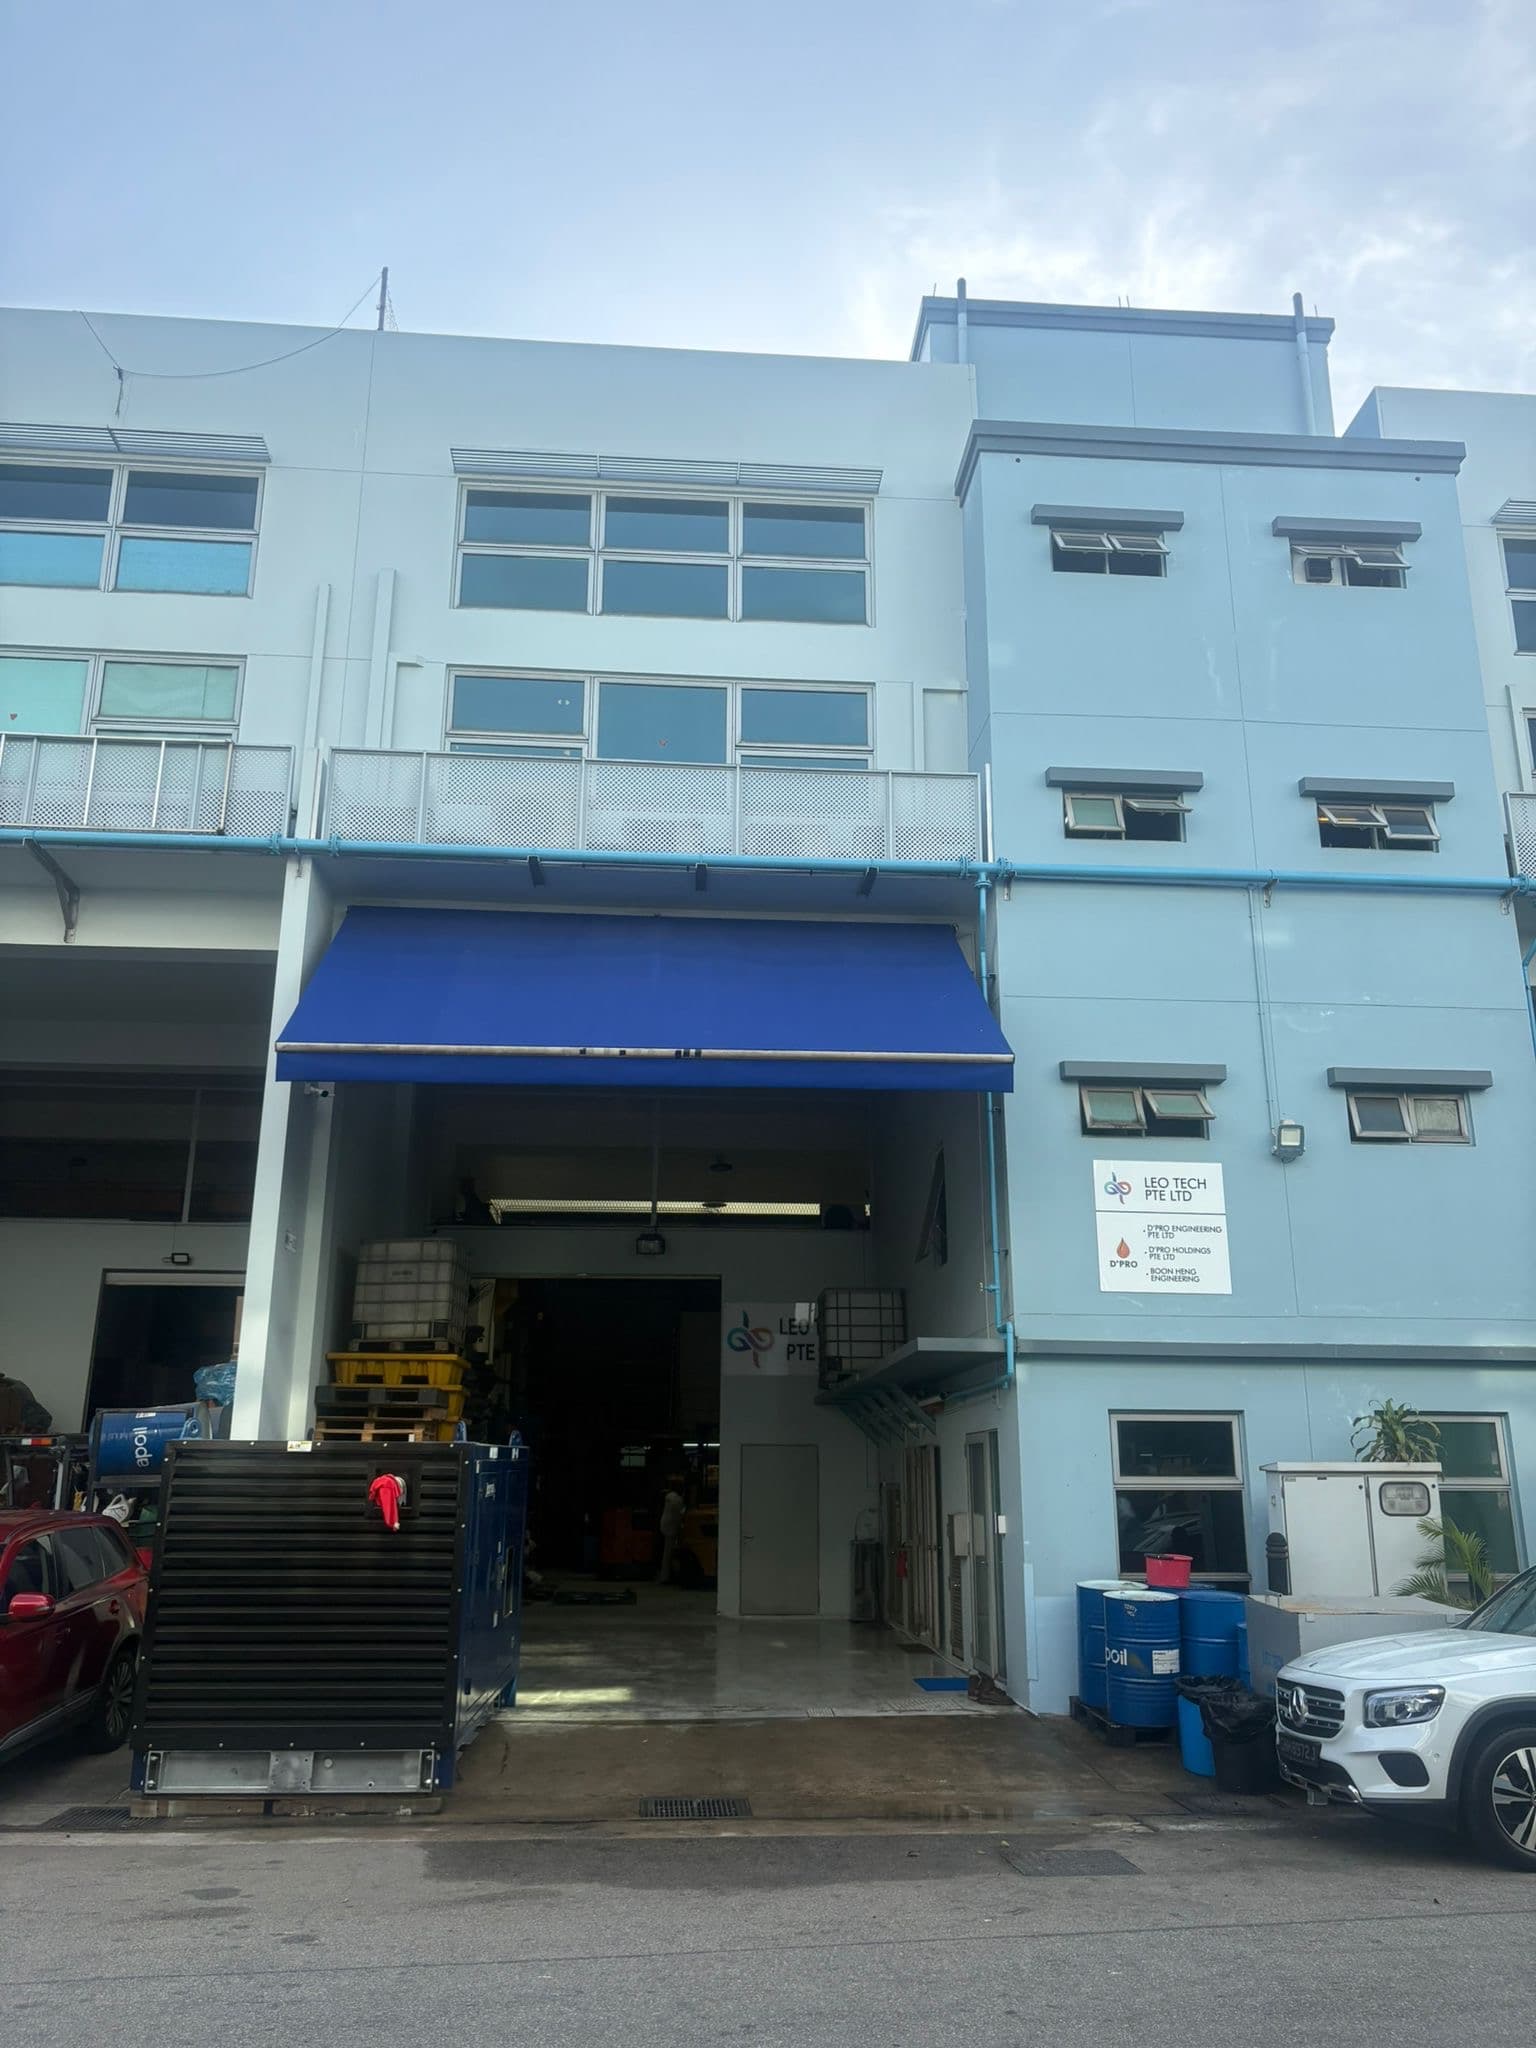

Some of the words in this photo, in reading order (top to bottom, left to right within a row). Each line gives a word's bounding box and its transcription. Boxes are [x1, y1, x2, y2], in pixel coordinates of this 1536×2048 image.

[1144, 1177, 1169, 1189] LEO
[1173, 1177, 1207, 1190] TECH
[1145, 1190, 1166, 1201] PTE
[1170, 1190, 1193, 1202] LTD
[1147, 1224, 1170, 1232] D'PRO
[1172, 1225, 1223, 1233] ENGINEERING
[1110, 1260, 1138, 1269] D'PRO
[1150, 1267, 1173, 1275] BOON
[1175, 1268, 1197, 1276] HENG
[1151, 1275, 1200, 1283] ENGINEERING
[779, 1317, 810, 1336] LEO
[787, 1343, 816, 1361] PTE
[132, 1426, 153, 1468] apoil
